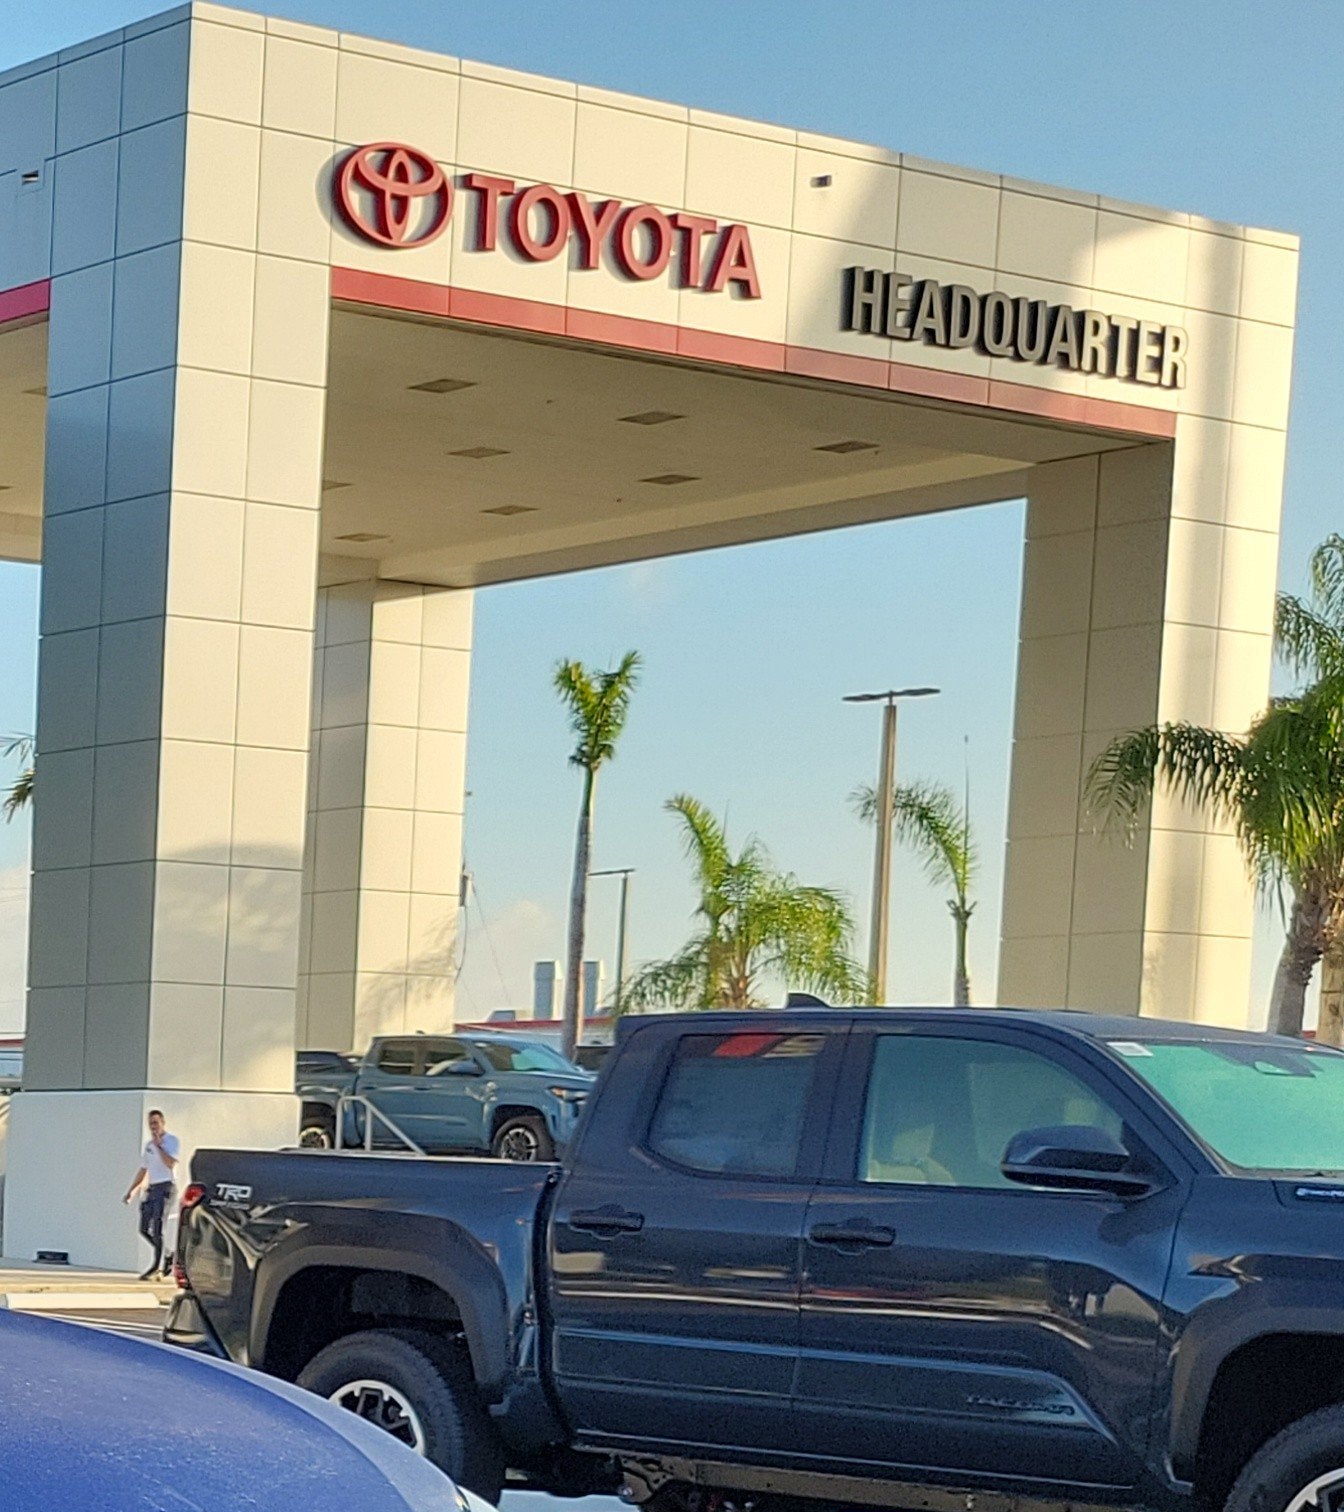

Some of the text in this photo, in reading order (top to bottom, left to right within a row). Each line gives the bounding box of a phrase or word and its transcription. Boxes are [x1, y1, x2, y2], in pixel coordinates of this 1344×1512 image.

[461, 171, 762, 300] TOYOTA
[846, 265, 1188, 390] HEADQUARTER
[215, 1182, 253, 1202] TRD
